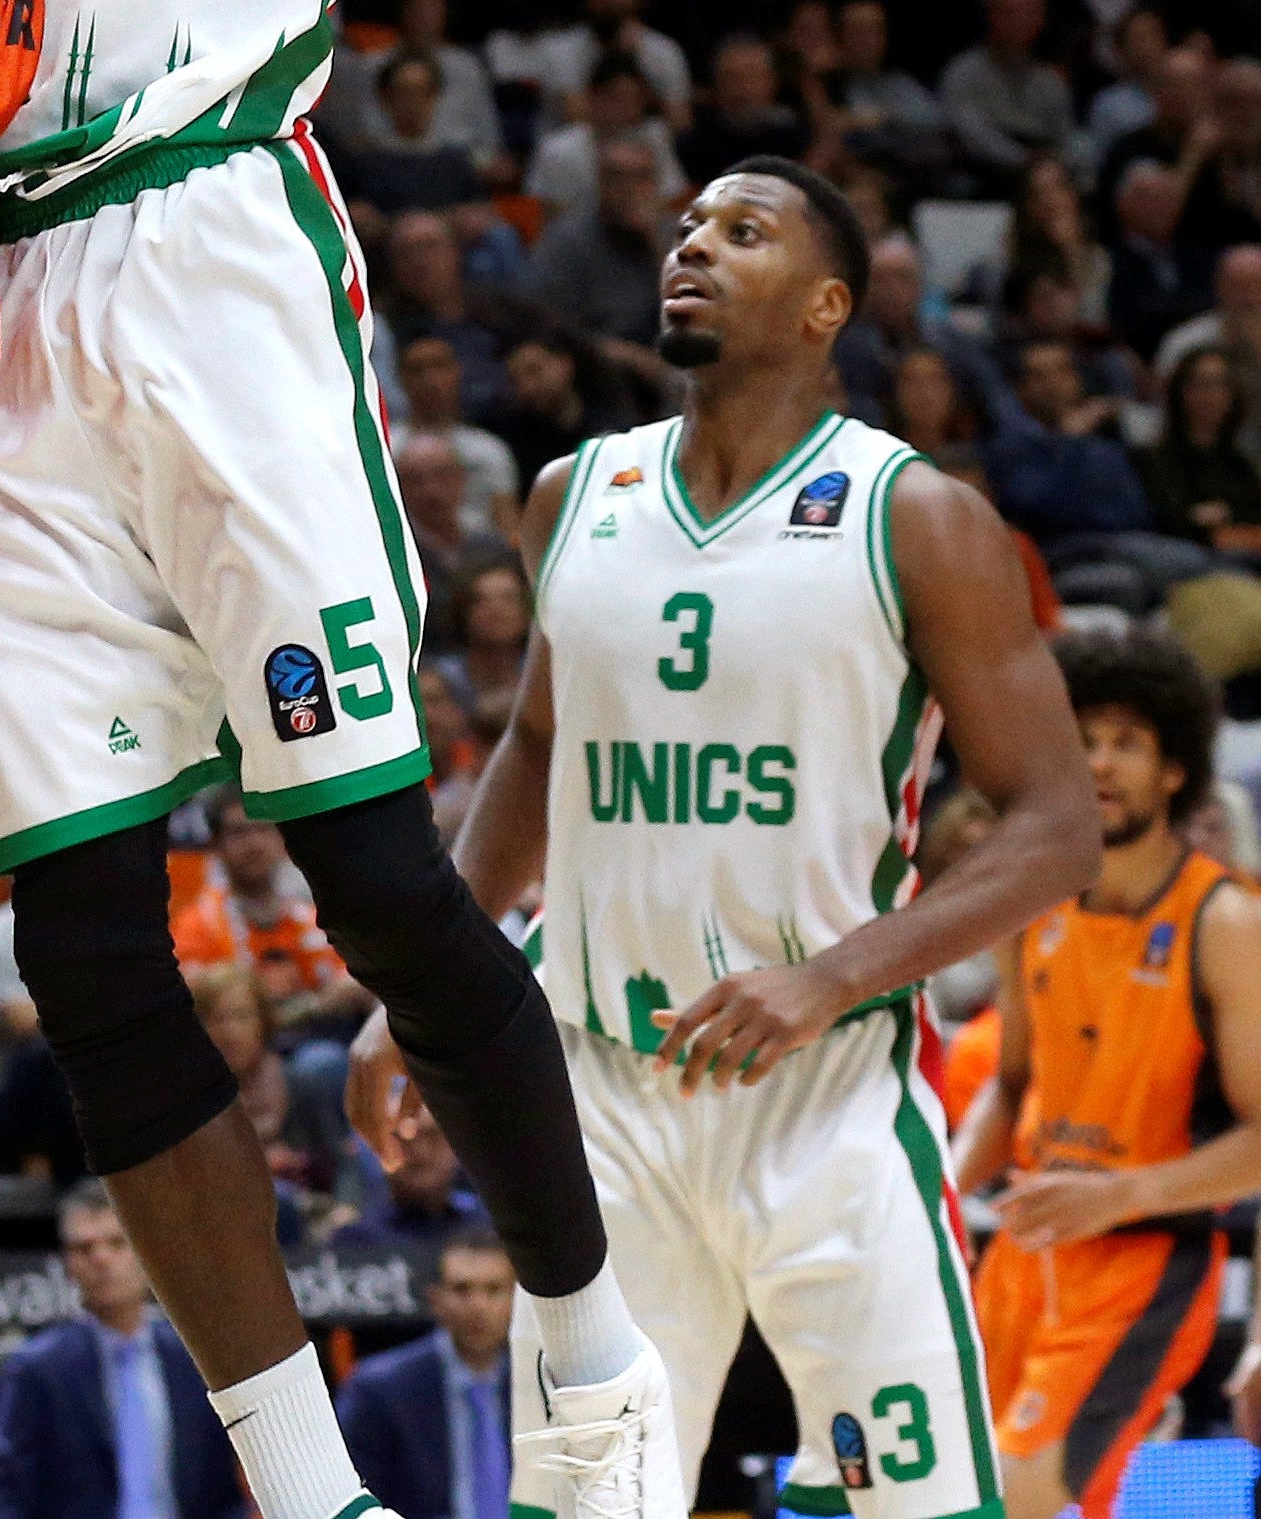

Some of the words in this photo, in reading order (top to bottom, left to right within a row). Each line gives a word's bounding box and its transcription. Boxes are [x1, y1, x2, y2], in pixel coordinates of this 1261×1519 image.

[319, 596, 394, 722] 5
[658, 592, 714, 692] 3
[584, 741, 797, 826] UNICS
[871, 1383, 936, 1483] 3
